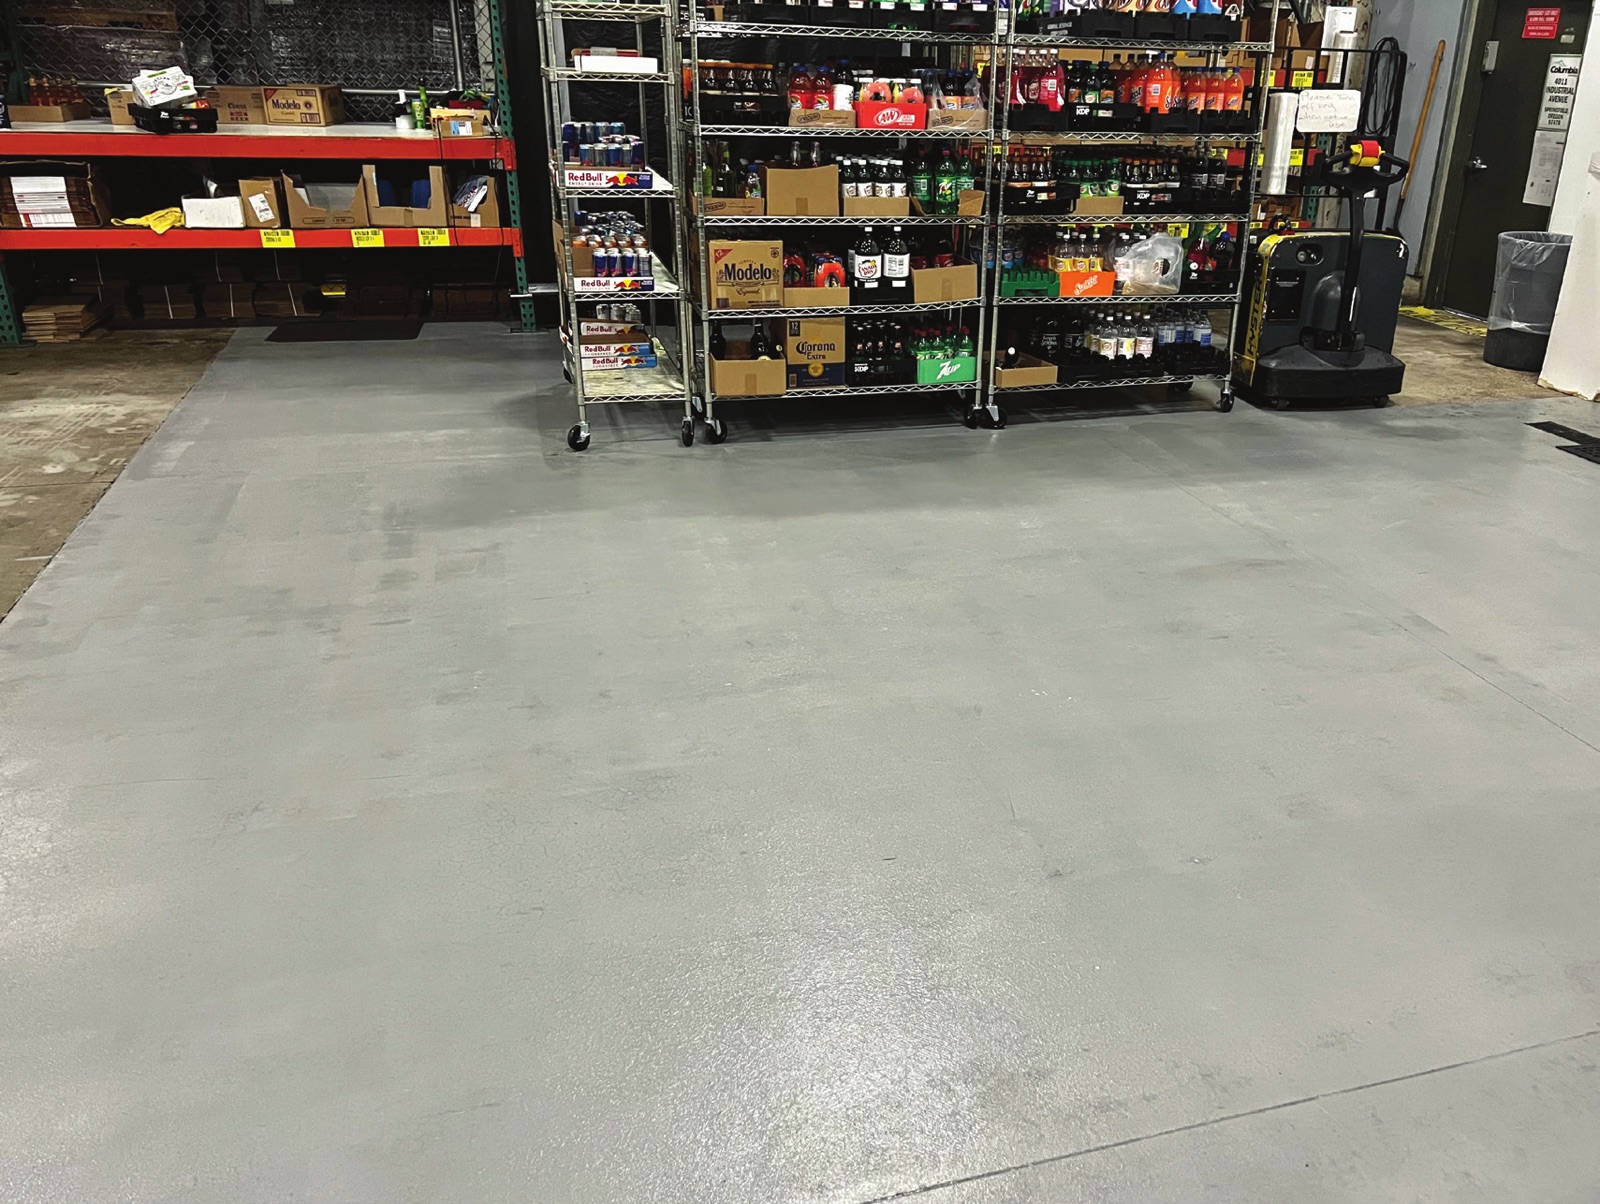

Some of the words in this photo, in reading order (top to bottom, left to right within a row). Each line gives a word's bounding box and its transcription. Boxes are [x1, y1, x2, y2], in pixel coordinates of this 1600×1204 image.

[1550, 65, 1579, 75] Columbia
[1554, 77, 1568, 86] 4011
[1545, 86, 1575, 95] INDUSTRIAL
[271, 98, 301, 110] Modelo
[1547, 95, 1569, 104] AVENUE
[568, 172, 585, 181] Red
[586, 172, 603, 181] Bull
[704, 202, 725, 212] napple
[724, 262, 772, 281] Modelo
[581, 279, 596, 287] Red
[596, 279, 611, 287] Bull
[586, 325, 599, 333] Red
[790, 321, 799, 330] 12
[584, 345, 598, 353] Red
[598, 345, 611, 353] Bull
[796, 341, 836, 356] Corona
[606, 357, 619, 365] Bull
